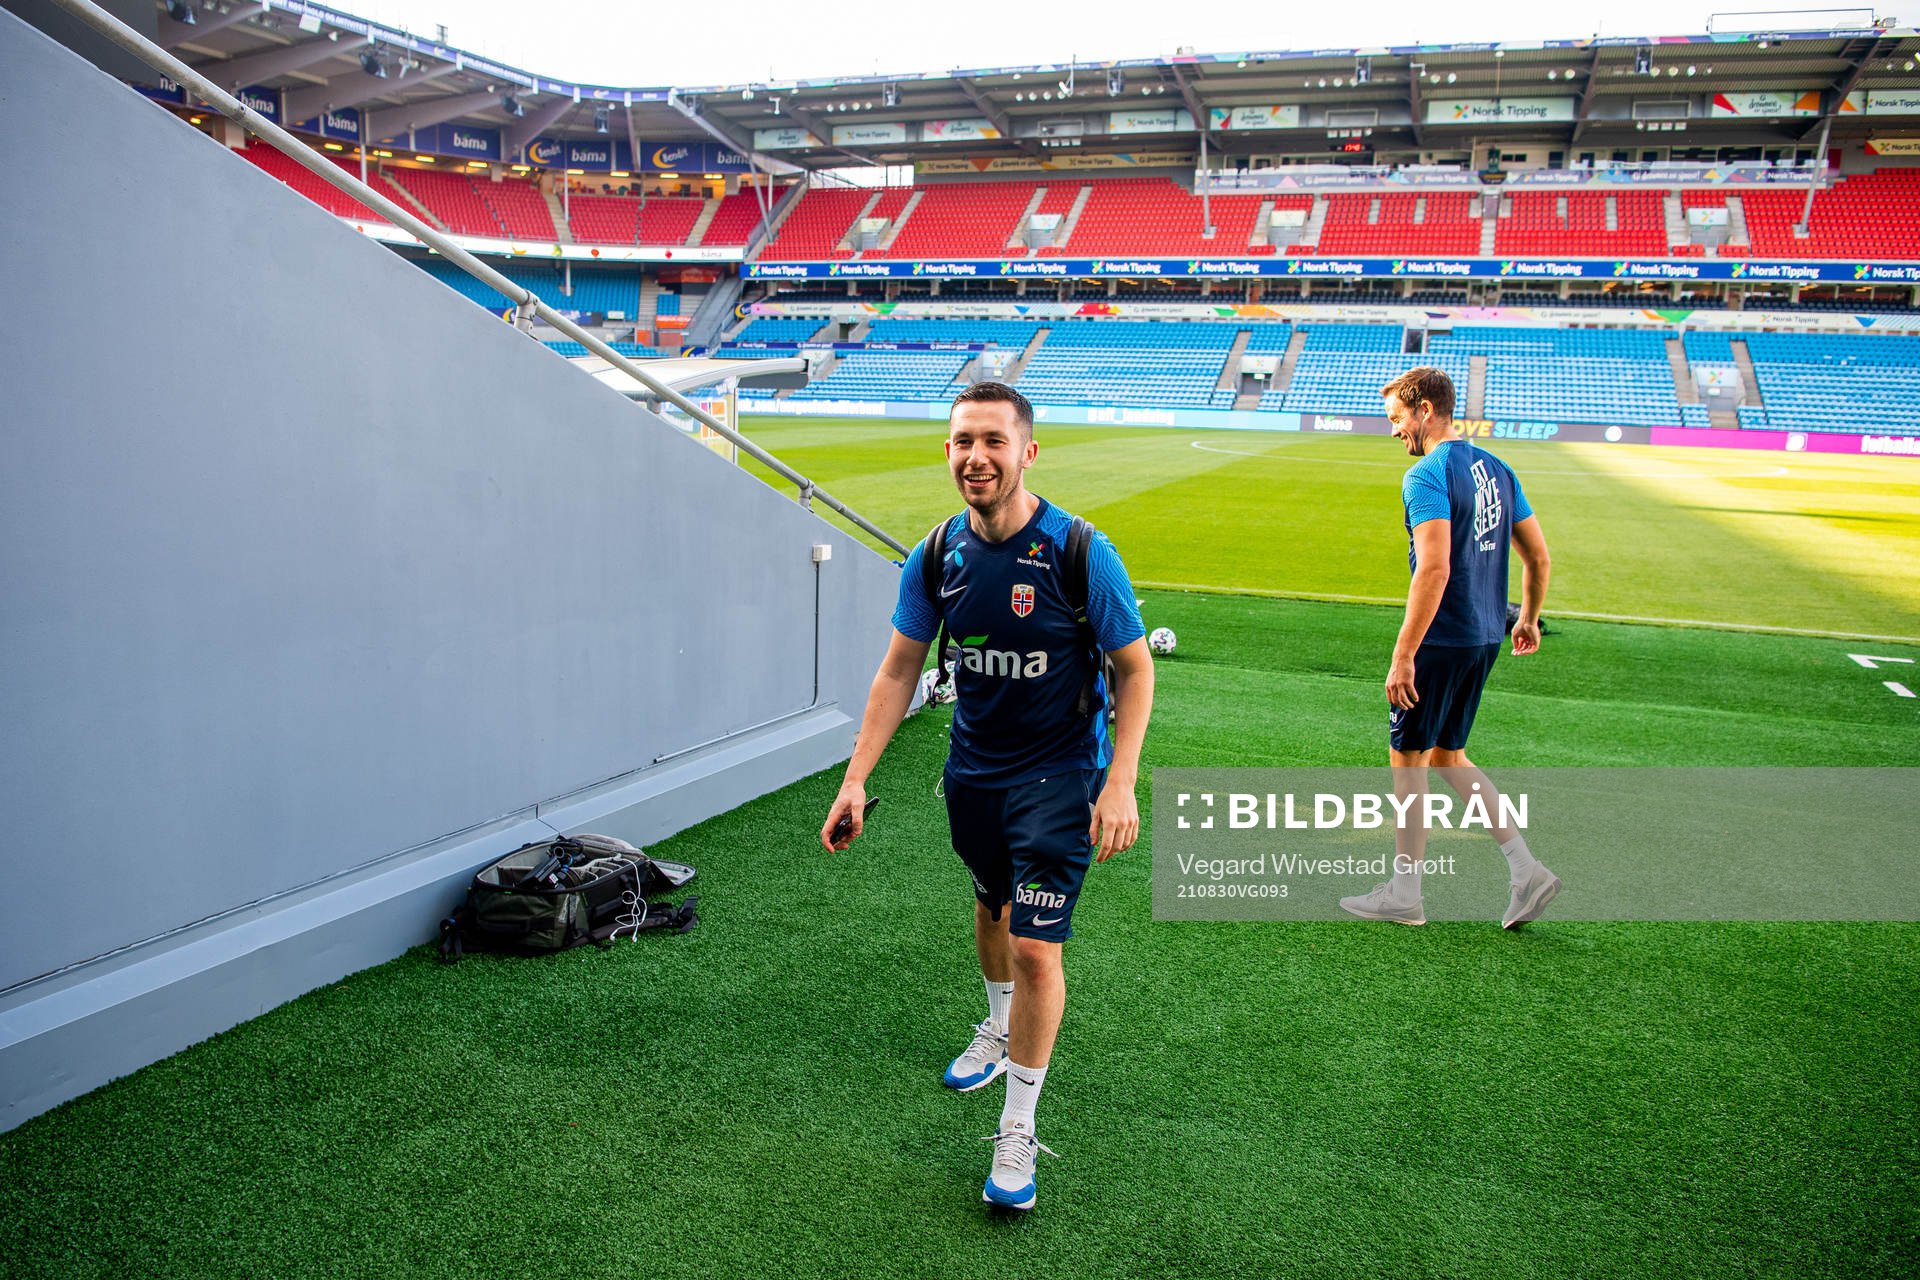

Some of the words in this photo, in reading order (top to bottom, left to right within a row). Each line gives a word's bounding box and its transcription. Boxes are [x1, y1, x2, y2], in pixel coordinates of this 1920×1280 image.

[1472, 107, 1504, 117] Norsk
[1506, 106, 1548, 118] Tipping
[328, 115, 357, 133] bama
[453, 132, 487, 150] bama
[571, 149, 606, 163] bama
[762, 266, 782, 275] Norsk
[783, 266, 807, 276] Tipping
[842, 265, 863, 274] Norsk
[864, 265, 890, 276] Tipping
[926, 264, 948, 274] Norsk
[949, 264, 976, 275] Tipping
[1014, 264, 1037, 272] Norsk
[1038, 264, 1066, 274] Tipping
[1106, 263, 1130, 272] Norsk
[1131, 263, 1161, 274] Tipping
[1202, 263, 1227, 272] Norsk
[1228, 263, 1260, 274] Tipping
[1303, 262, 1329, 272] Norsk
[1330, 262, 1363, 274] Tipping
[1408, 262, 1434, 272] Norsk
[1435, 263, 1470, 275] Tipping
[1517, 263, 1546, 274] Norsk
[1547, 264, 1582, 276] Tipping
[1631, 264, 1660, 275] Norsk
[1661, 264, 1700, 278] Tipping
[1750, 266, 1780, 276] Norsk
[1781, 266, 1820, 279] Tipping
[1794, 316, 1820, 324] Tipping
[1314, 415, 1352, 431] bama
[1452, 419, 1493, 438] OVE
[1493, 421, 1559, 440] SLEEP
[962, 648, 1048, 680] ama
[1016, 882, 1067, 909] bama
